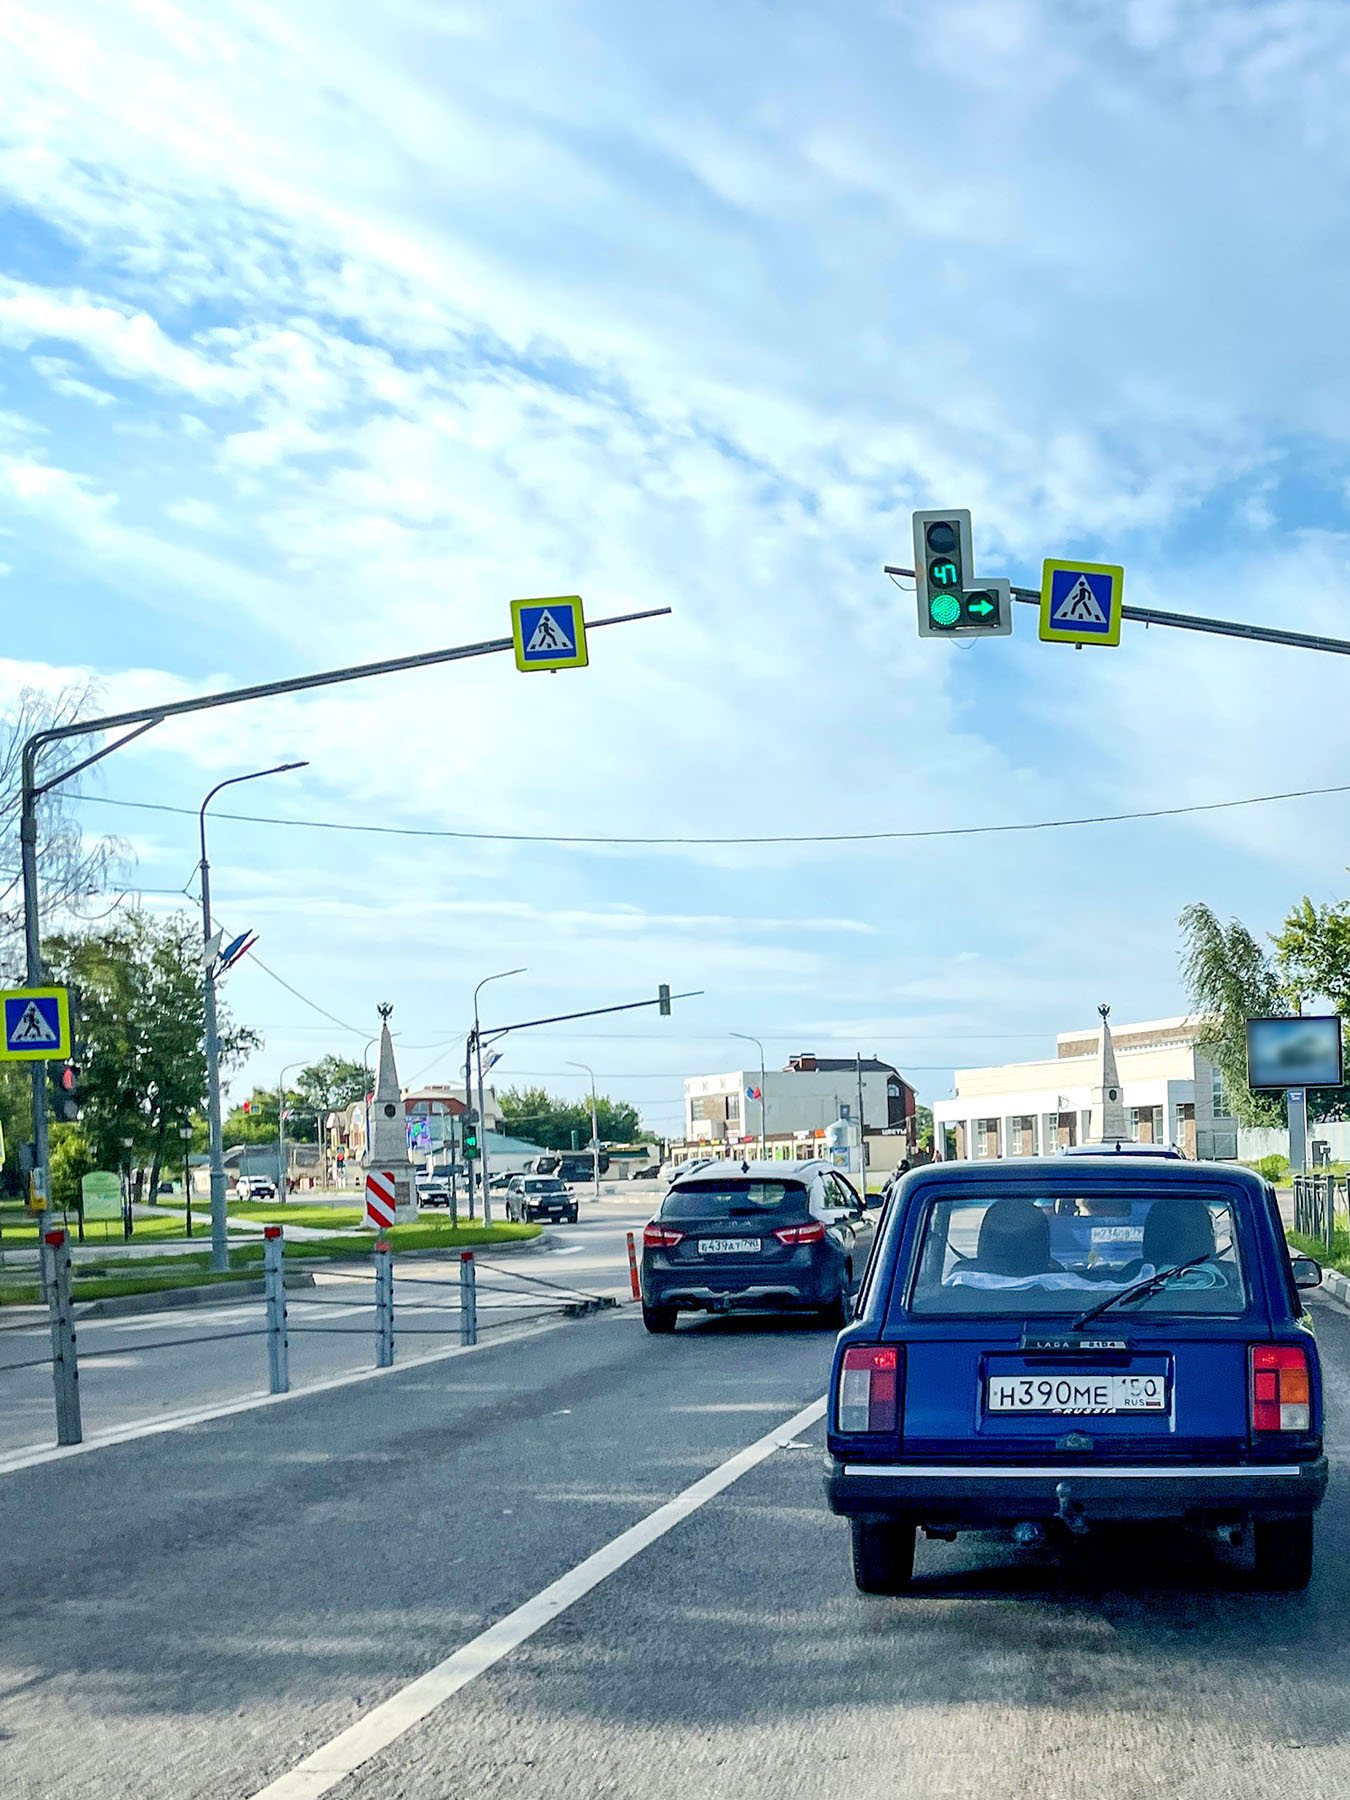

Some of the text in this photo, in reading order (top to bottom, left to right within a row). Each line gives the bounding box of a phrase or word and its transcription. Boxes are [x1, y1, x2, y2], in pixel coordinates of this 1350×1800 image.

[934, 564, 957, 584] 47
[1000, 1378, 1157, 1406] Н390МЕ 50
